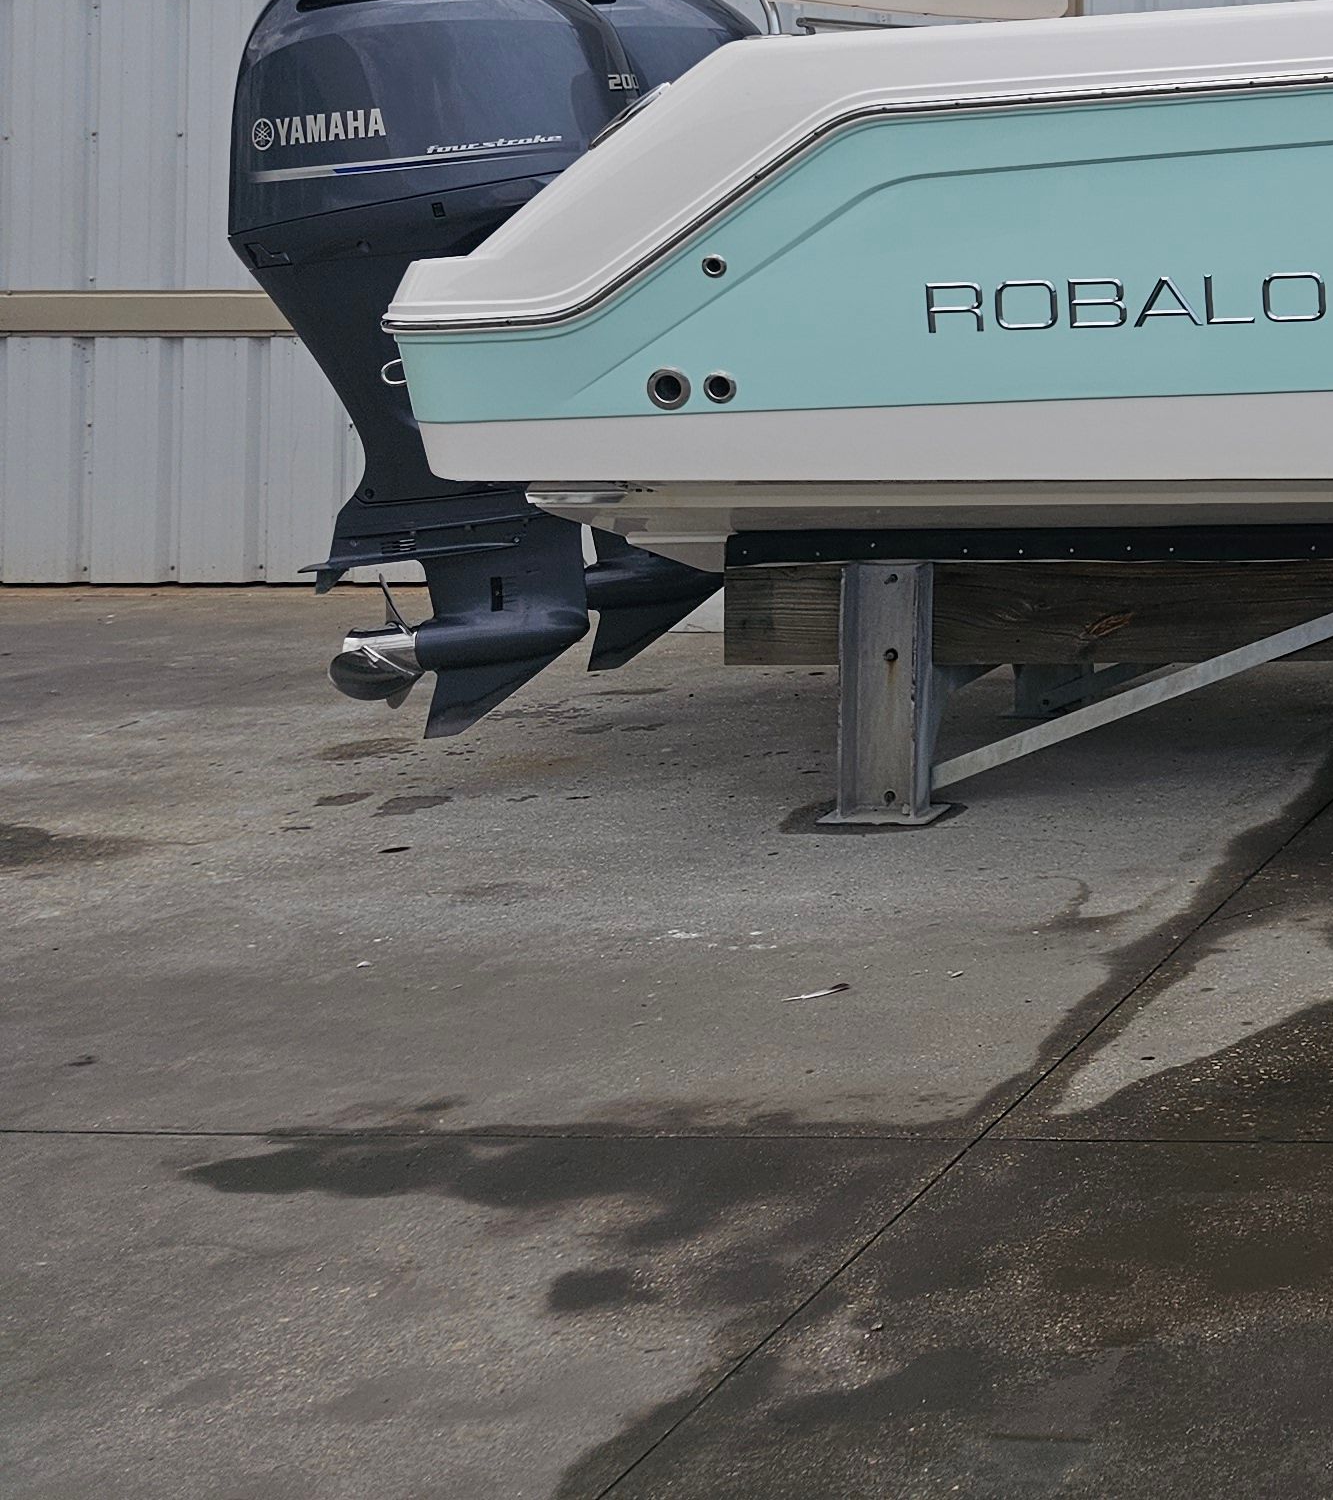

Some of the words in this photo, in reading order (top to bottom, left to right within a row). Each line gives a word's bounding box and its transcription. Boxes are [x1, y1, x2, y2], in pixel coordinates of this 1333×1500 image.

[608, 73, 639, 90] 200
[275, 109, 387, 146] YAMAHA
[924, 271, 1328, 334] ROBALO
